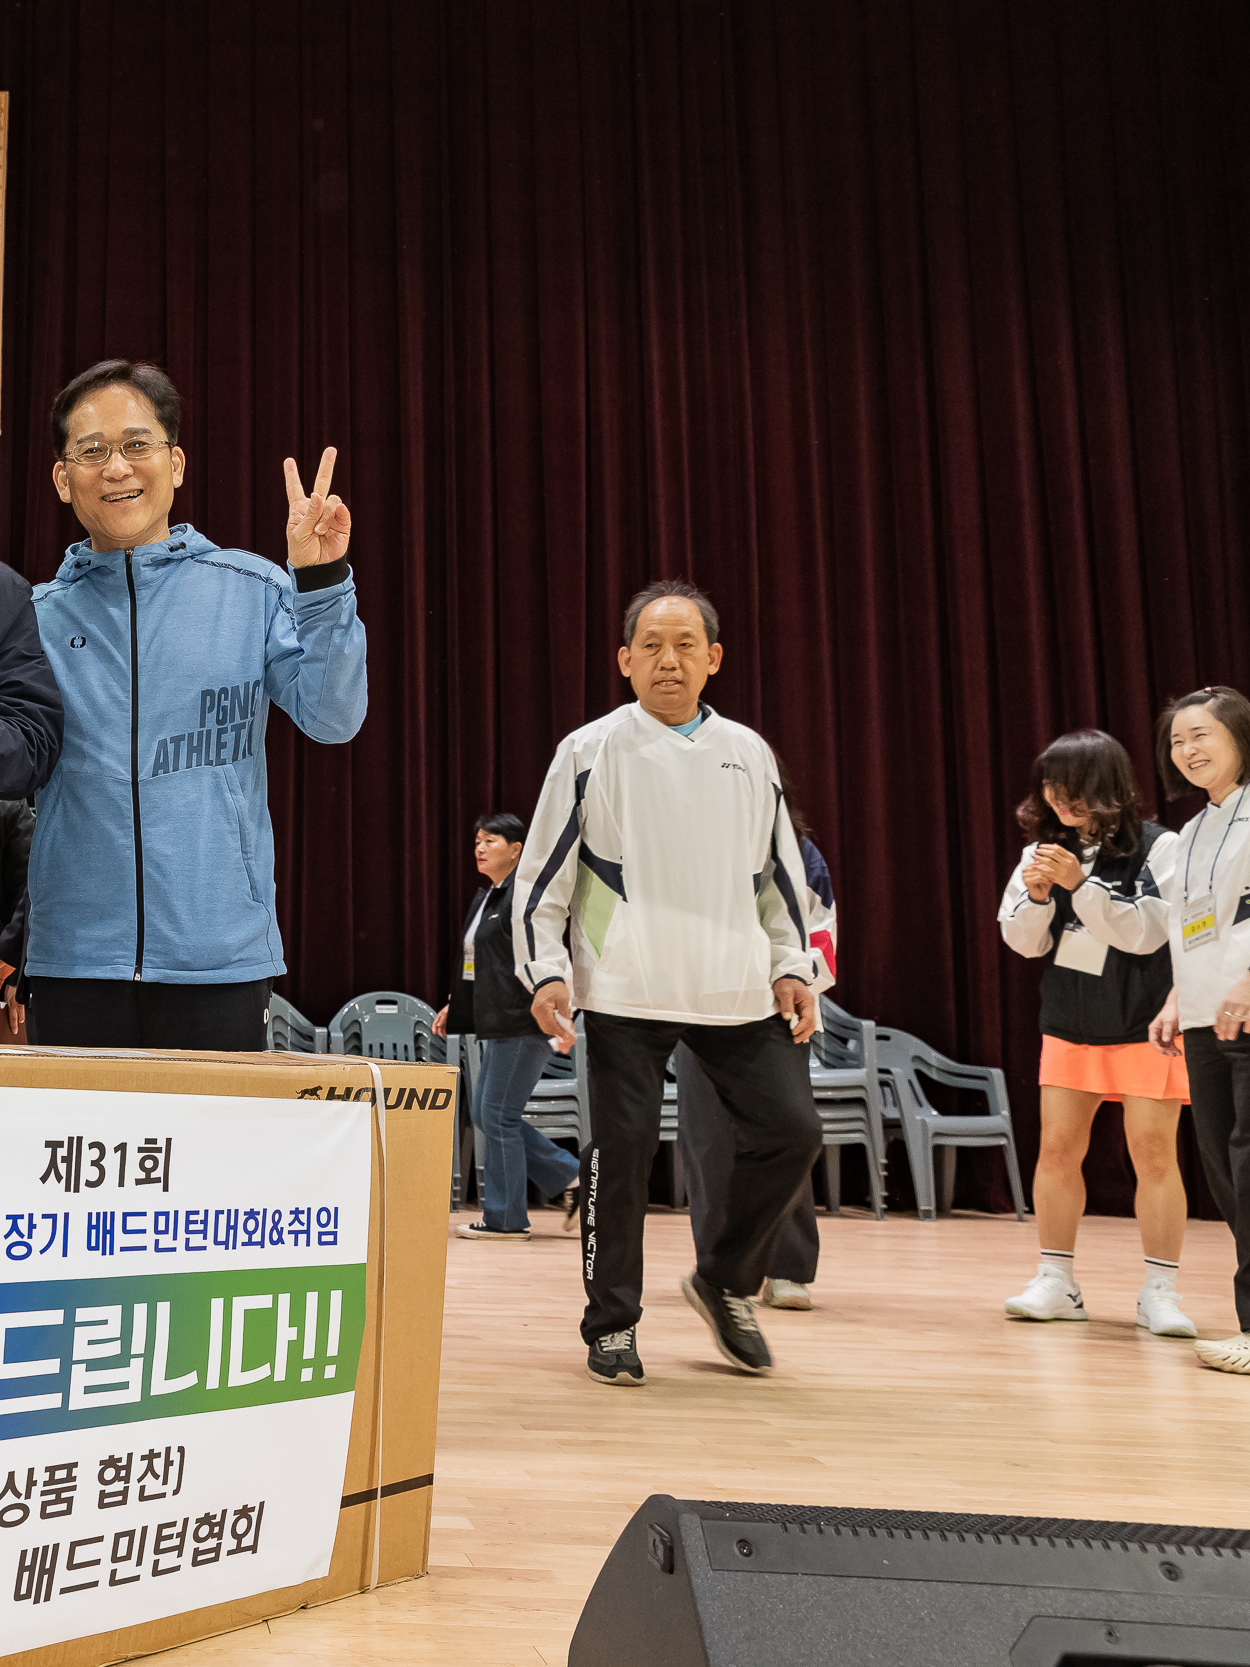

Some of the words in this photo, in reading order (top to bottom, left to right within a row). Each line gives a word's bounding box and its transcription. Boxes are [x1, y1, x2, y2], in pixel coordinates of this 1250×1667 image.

[39, 1136, 173, 1193] 제31회
[587, 1148, 599, 1226] SIGNATURE
[86, 1206, 339, 1256] 배드민턴대회&취임
[585, 1231, 596, 1280] VICTOR
[13, 1501, 265, 1605] 배드민턴협회
